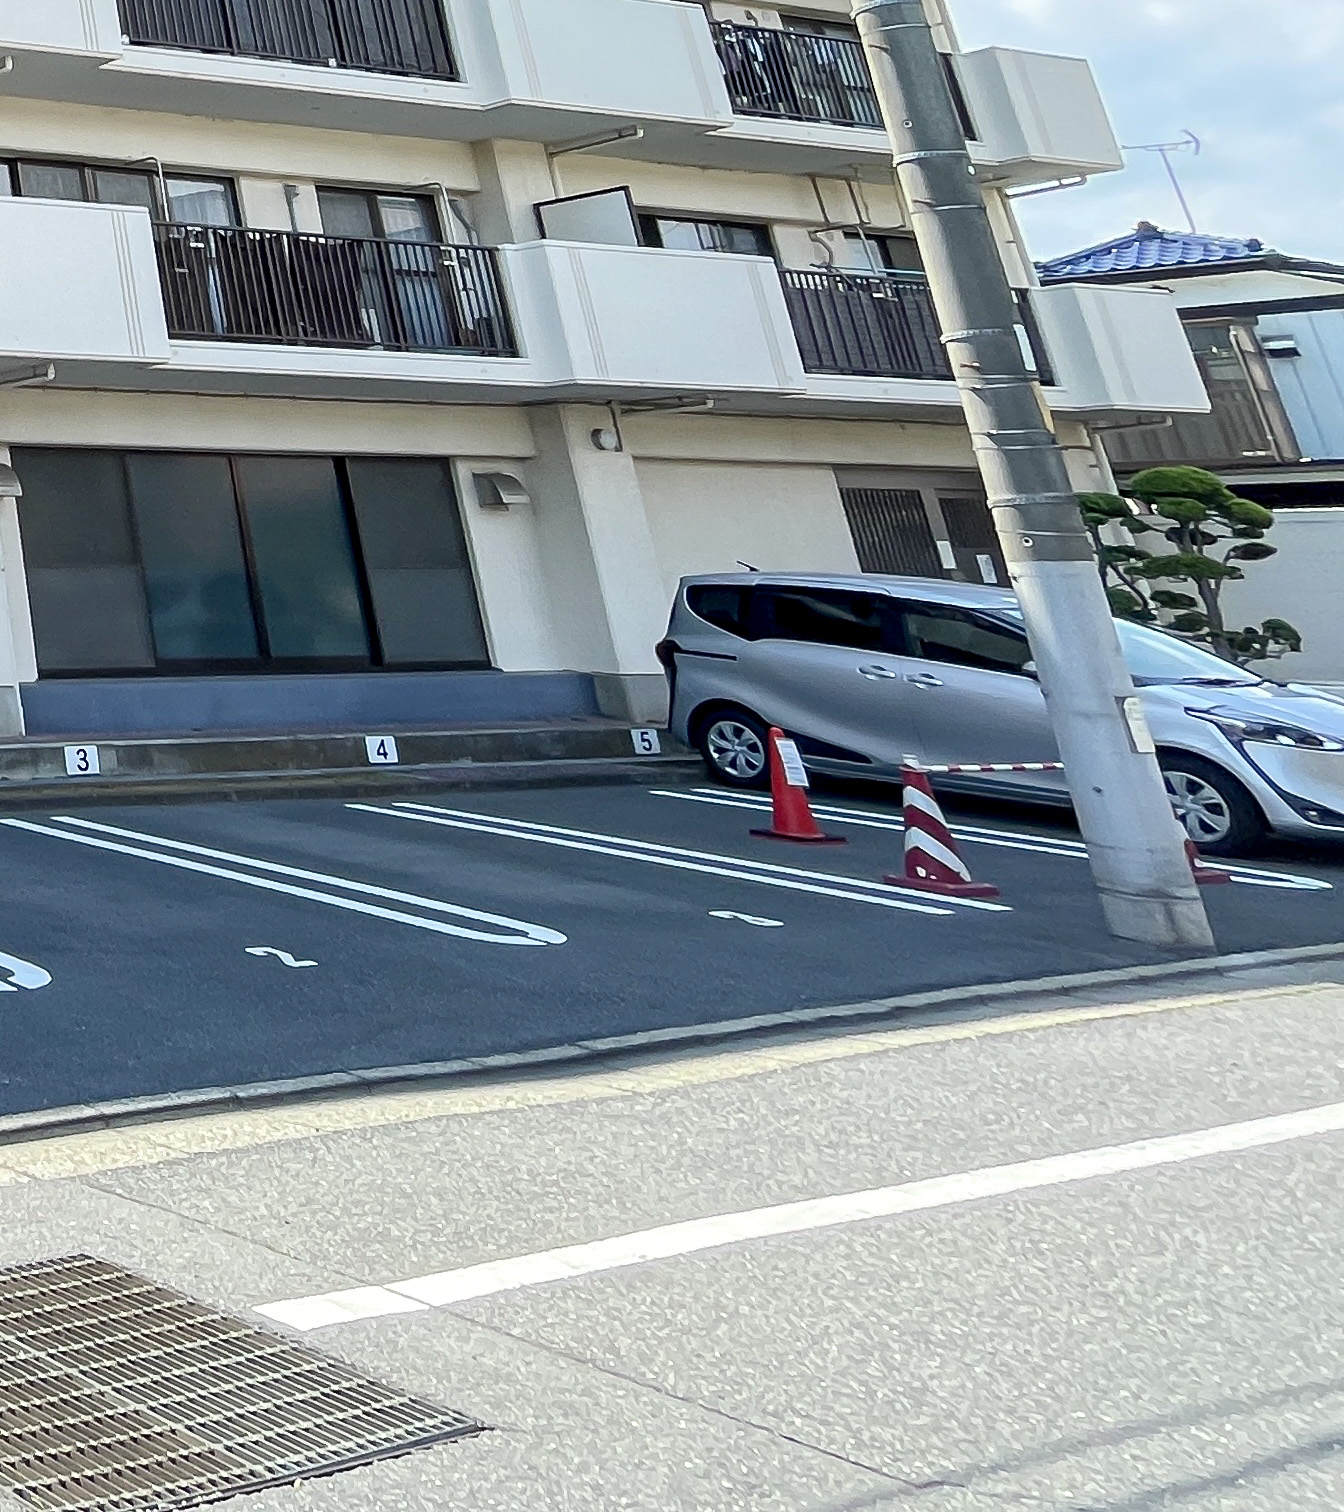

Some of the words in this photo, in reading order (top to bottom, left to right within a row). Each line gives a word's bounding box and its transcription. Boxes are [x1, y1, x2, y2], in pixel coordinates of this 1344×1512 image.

[376, 738, 389, 760] 4
[640, 731, 653, 752] 5
[76, 748, 90, 772] 3
